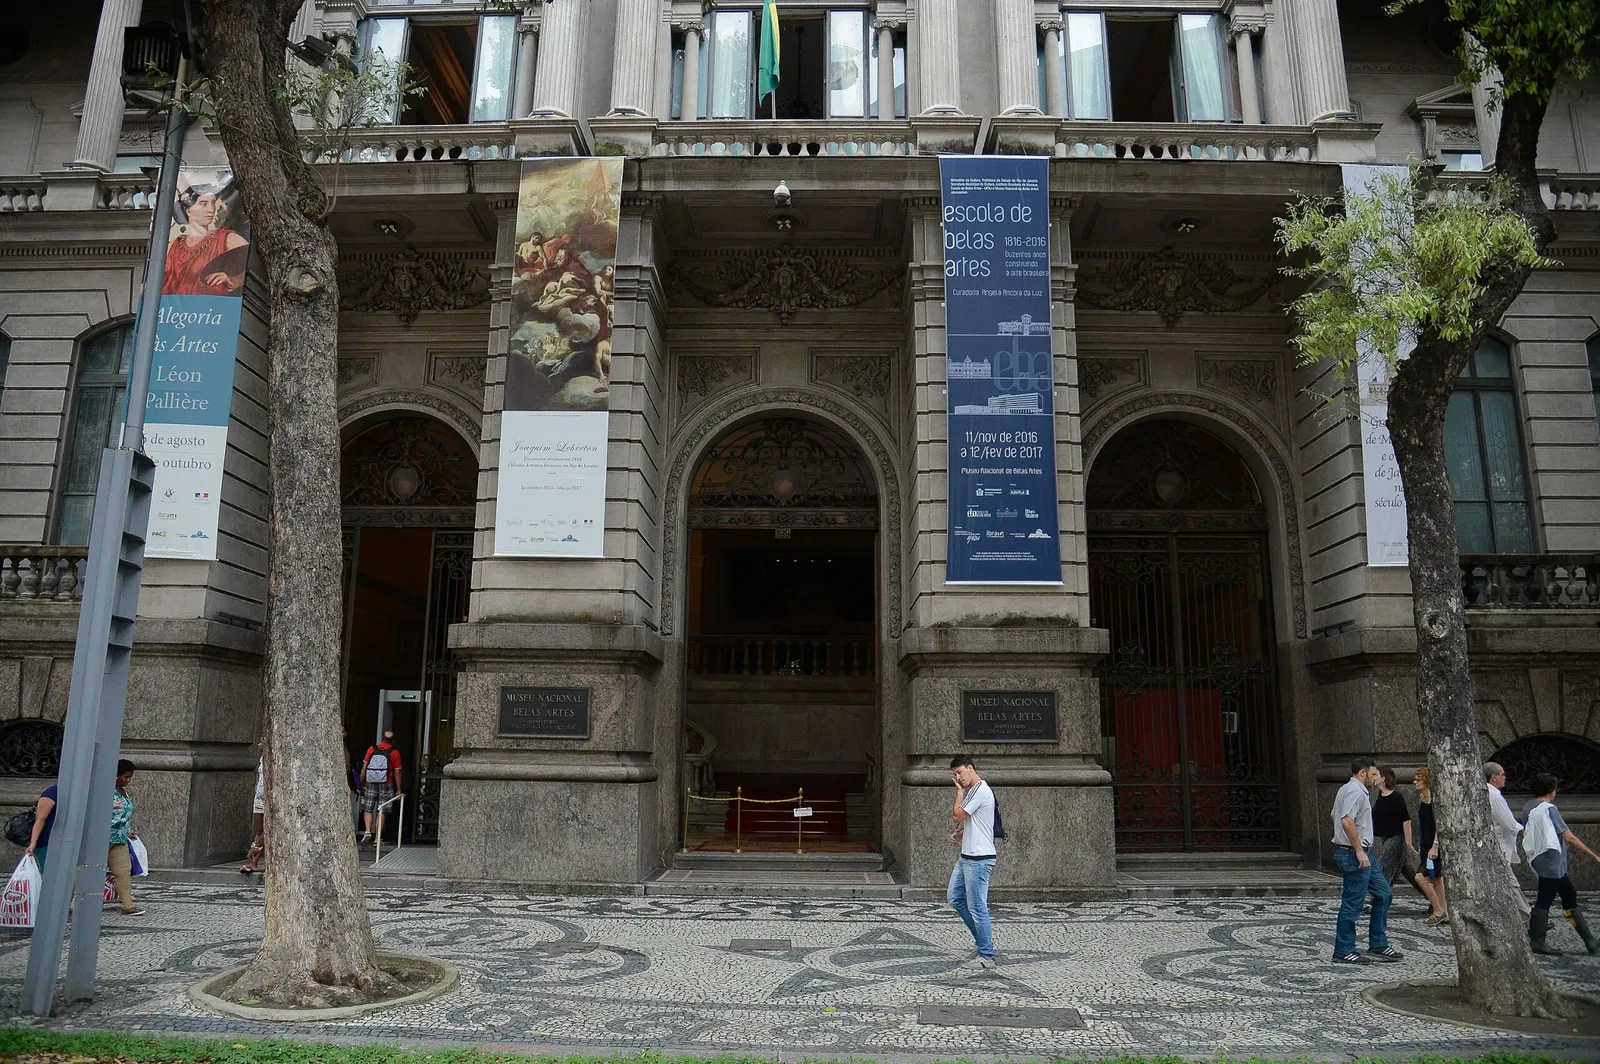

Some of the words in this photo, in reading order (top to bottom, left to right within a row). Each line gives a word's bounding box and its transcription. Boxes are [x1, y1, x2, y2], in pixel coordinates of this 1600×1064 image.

[944, 203, 1005, 223] escola
[1010, 203, 1032, 223] de
[944, 229, 995, 250] belas
[1004, 236, 1046, 247] 1816-2016
[945, 256, 990, 277] artes
[158, 306, 222, 329] Alegoria
[170, 335, 218, 354] Artes
[156, 366, 202, 382] Léon
[146, 392, 209, 410] Pallière
[151, 433, 164, 444] de
[167, 436, 205, 448] agosto
[965, 431, 997, 444] 11/nov
[1000, 431, 1012, 443] de
[1015, 432, 1038, 443] 2016
[1366, 432, 1376, 444] de
[509, 440, 551, 454] Joaquim
[555, 440, 598, 452] Lebreton
[960, 449, 967, 458] a
[970, 446, 1001, 459] 12/fev
[1004, 446, 1017, 458] de
[1020, 447, 1043, 458] 2017
[163, 458, 212, 469] outubro
[1375, 465, 1386, 477] de
[1374, 495, 1403, 508] século
[507, 694, 535, 702] MUSEU
[539, 694, 582, 702] NACIONAL
[970, 698, 999, 707] MUSEU
[1003, 698, 1050, 707] NACIONAL
[513, 708, 540, 716] BELAS
[545, 709, 575, 717] ARTES
